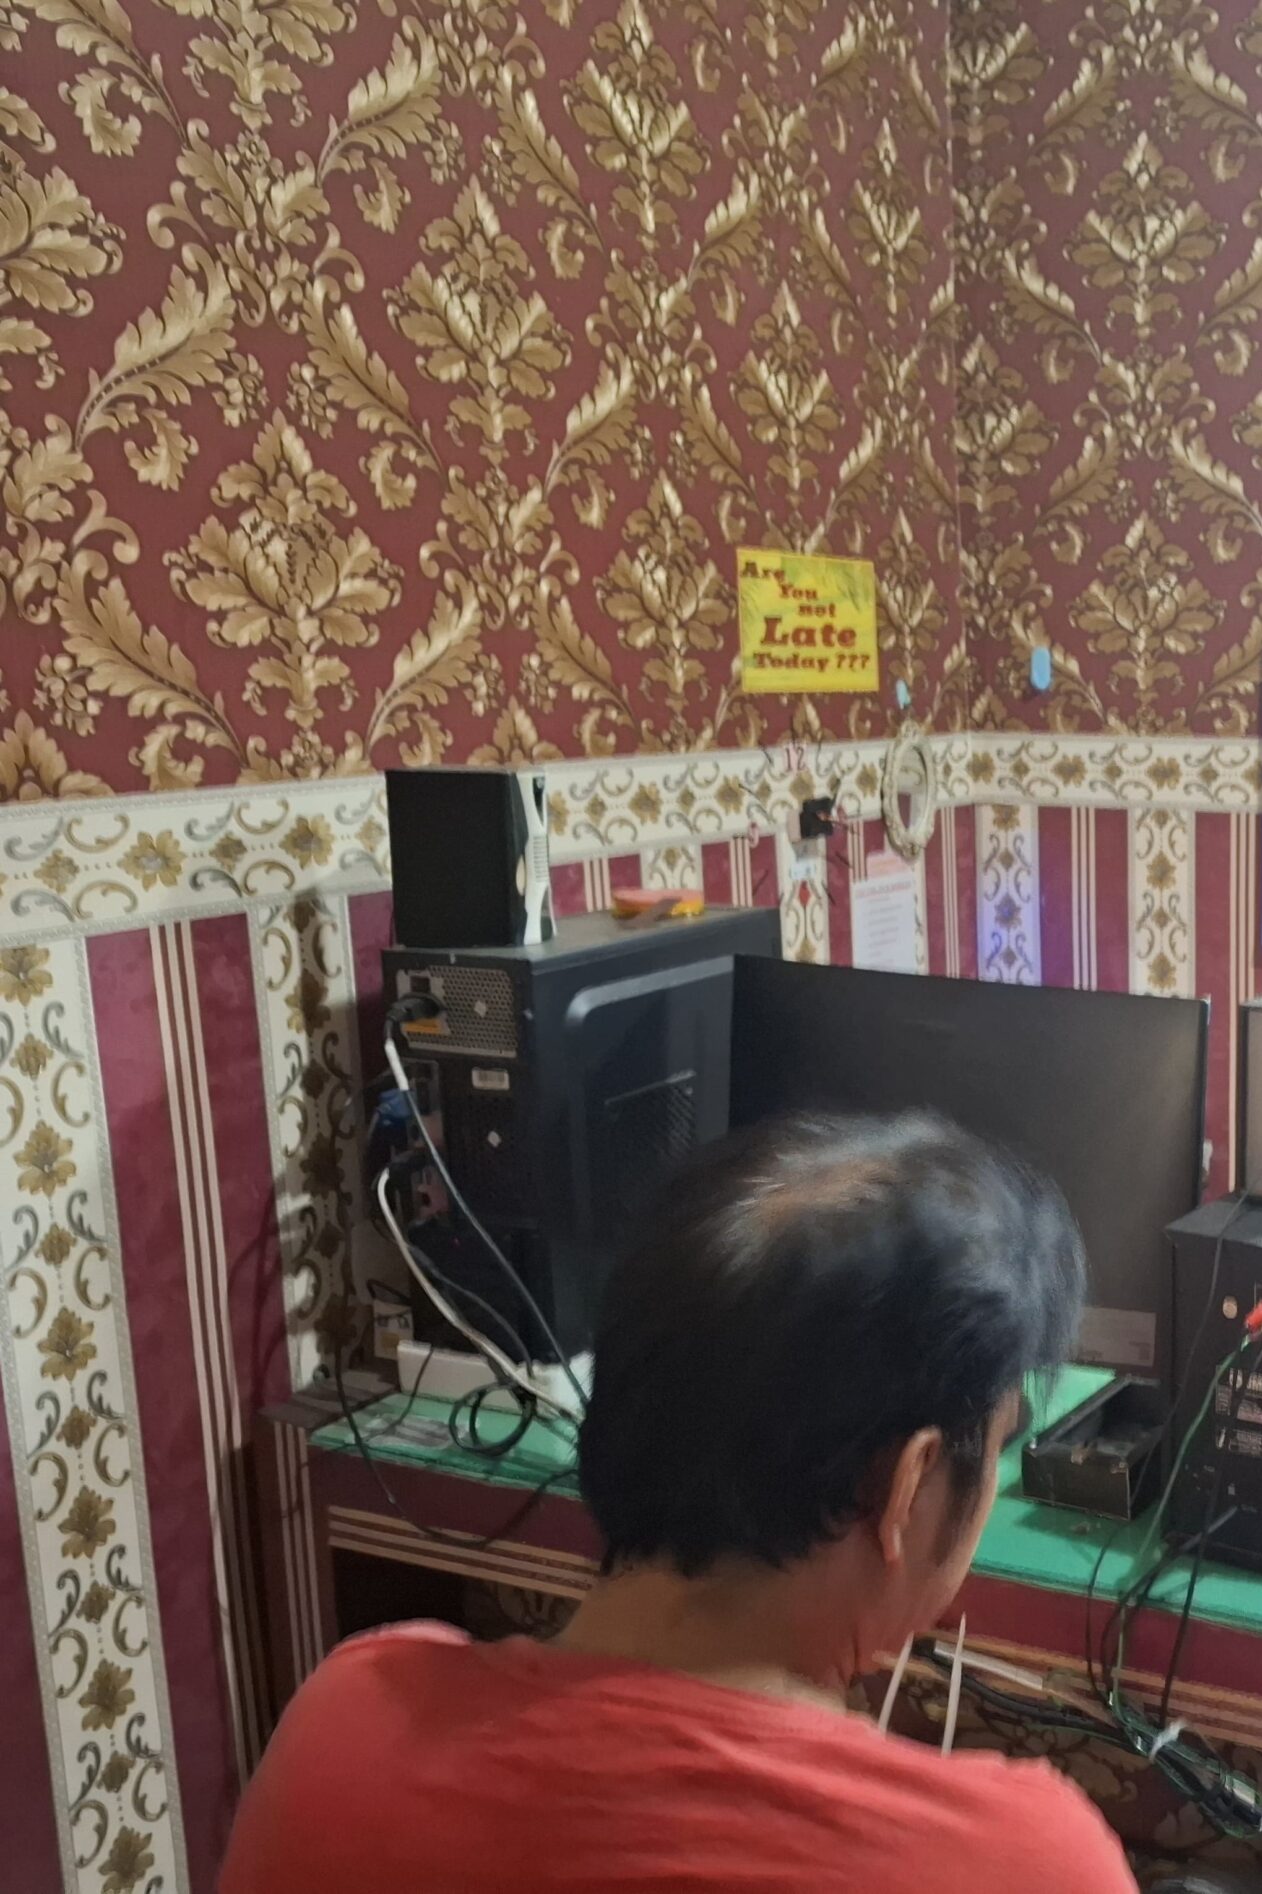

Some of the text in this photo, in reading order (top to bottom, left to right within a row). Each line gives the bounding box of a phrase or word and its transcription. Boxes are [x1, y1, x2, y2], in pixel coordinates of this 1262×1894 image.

[741, 561, 786, 580] Are
[780, 583, 818, 600] You
[798, 603, 837, 618] not
[760, 616, 857, 647] Late
[753, 652, 871, 672] Today ???
